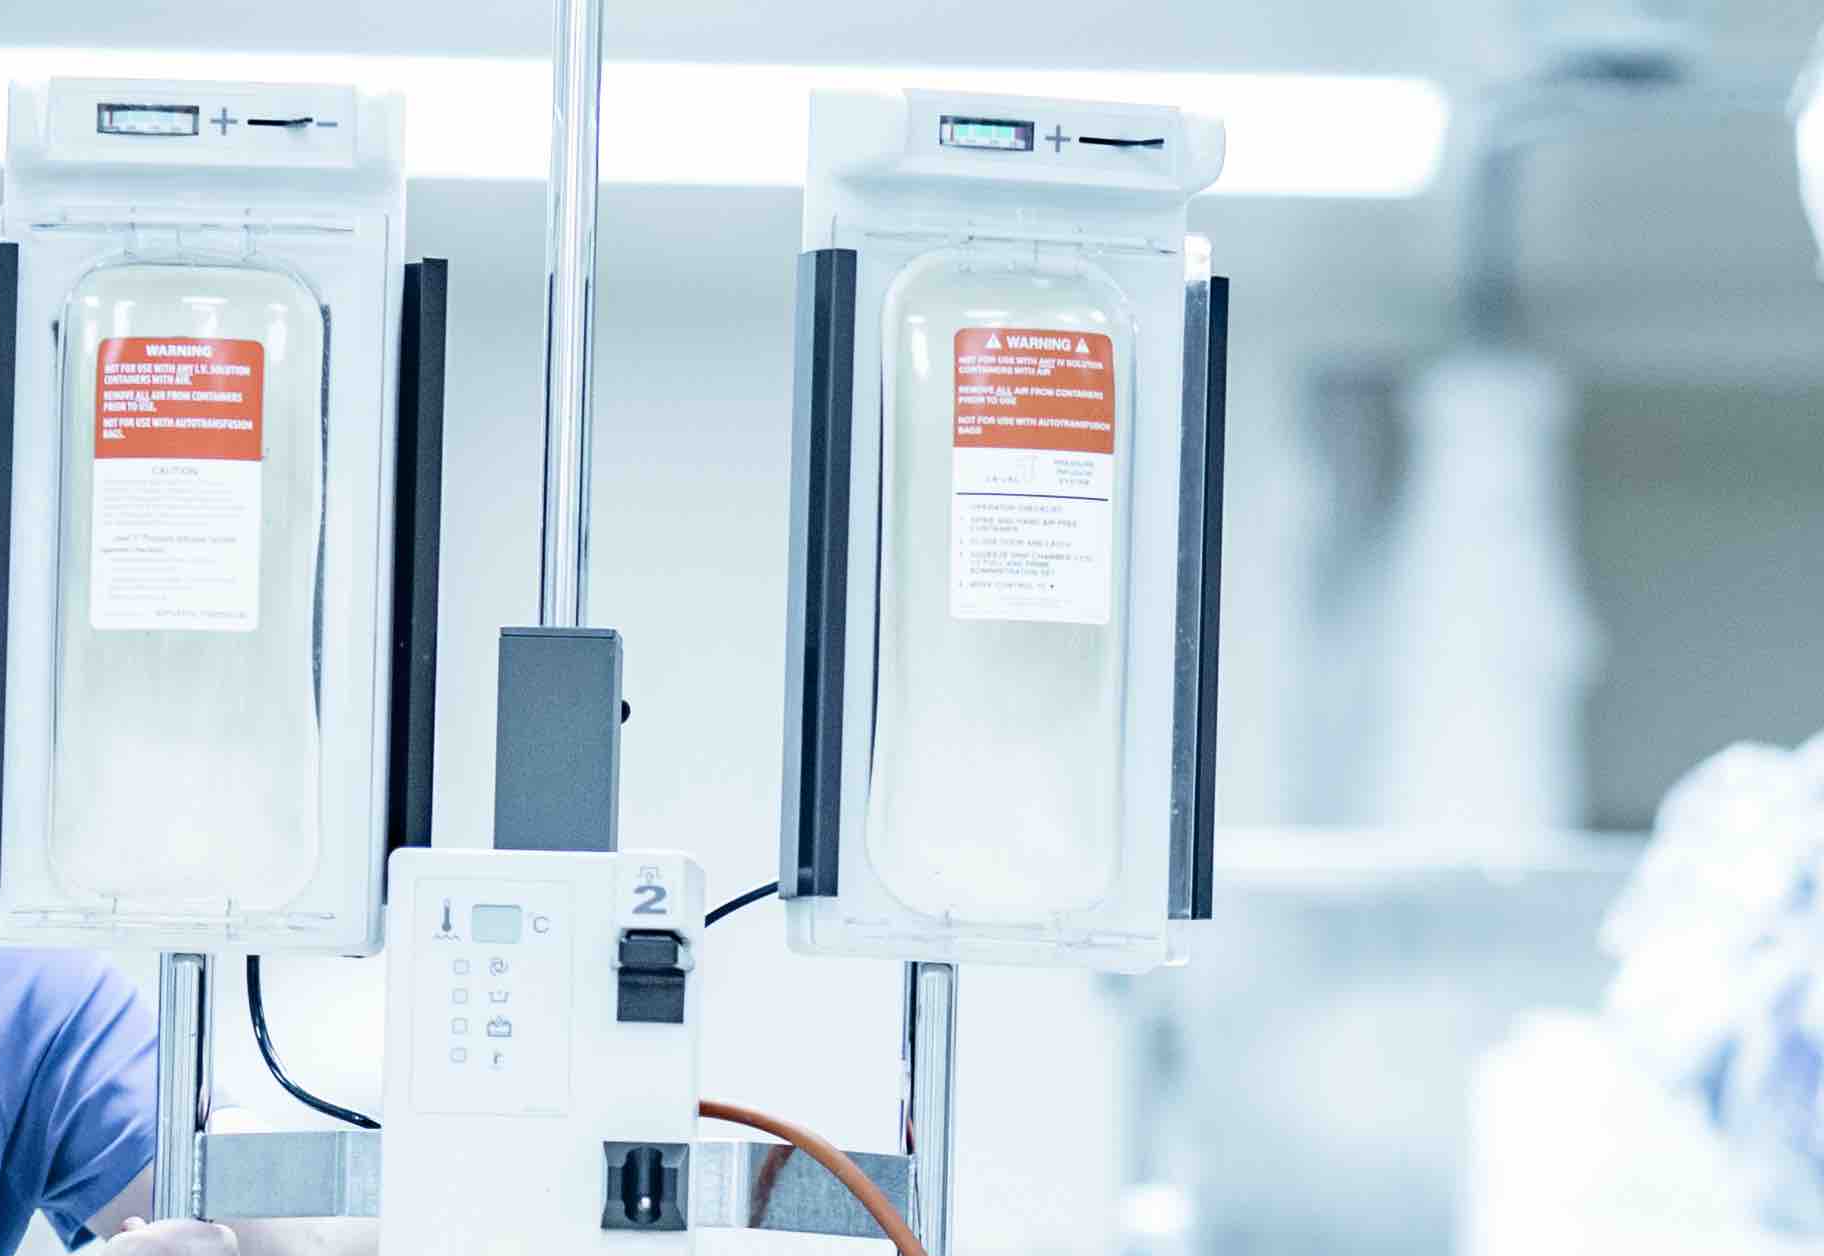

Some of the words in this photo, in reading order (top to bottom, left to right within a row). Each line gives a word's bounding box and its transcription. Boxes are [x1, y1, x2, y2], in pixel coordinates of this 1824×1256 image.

[1006, 336, 1072, 351] WARNING
[145, 344, 212, 357] WARNING
[154, 363, 175, 374] WITH
[152, 374, 174, 385] WITH
[632, 885, 667, 914] 2
